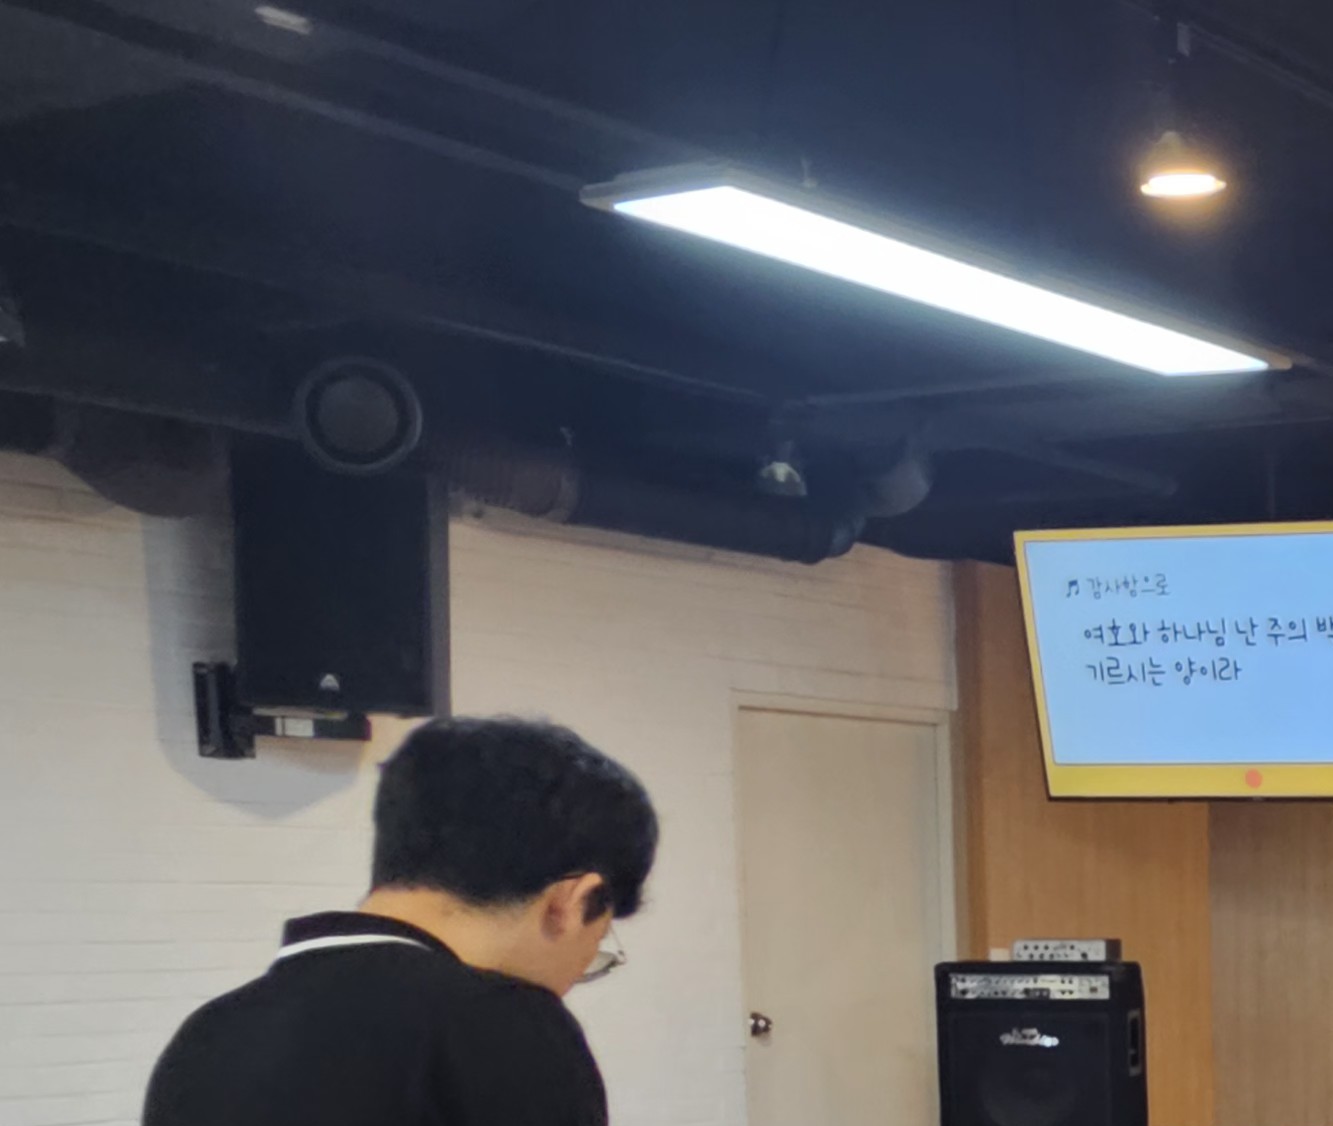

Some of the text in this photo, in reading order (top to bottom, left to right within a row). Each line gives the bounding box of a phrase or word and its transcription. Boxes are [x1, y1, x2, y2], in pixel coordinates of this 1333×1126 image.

[1087, 573, 1170, 599] 감사함으로
[1084, 617, 1150, 648] 여호와
[1157, 617, 1227, 648] 하나님
[1235, 617, 1259, 647] 난
[1267, 617, 1308, 647] 주의
[1086, 656, 1243, 686] 기르시는 양이라
